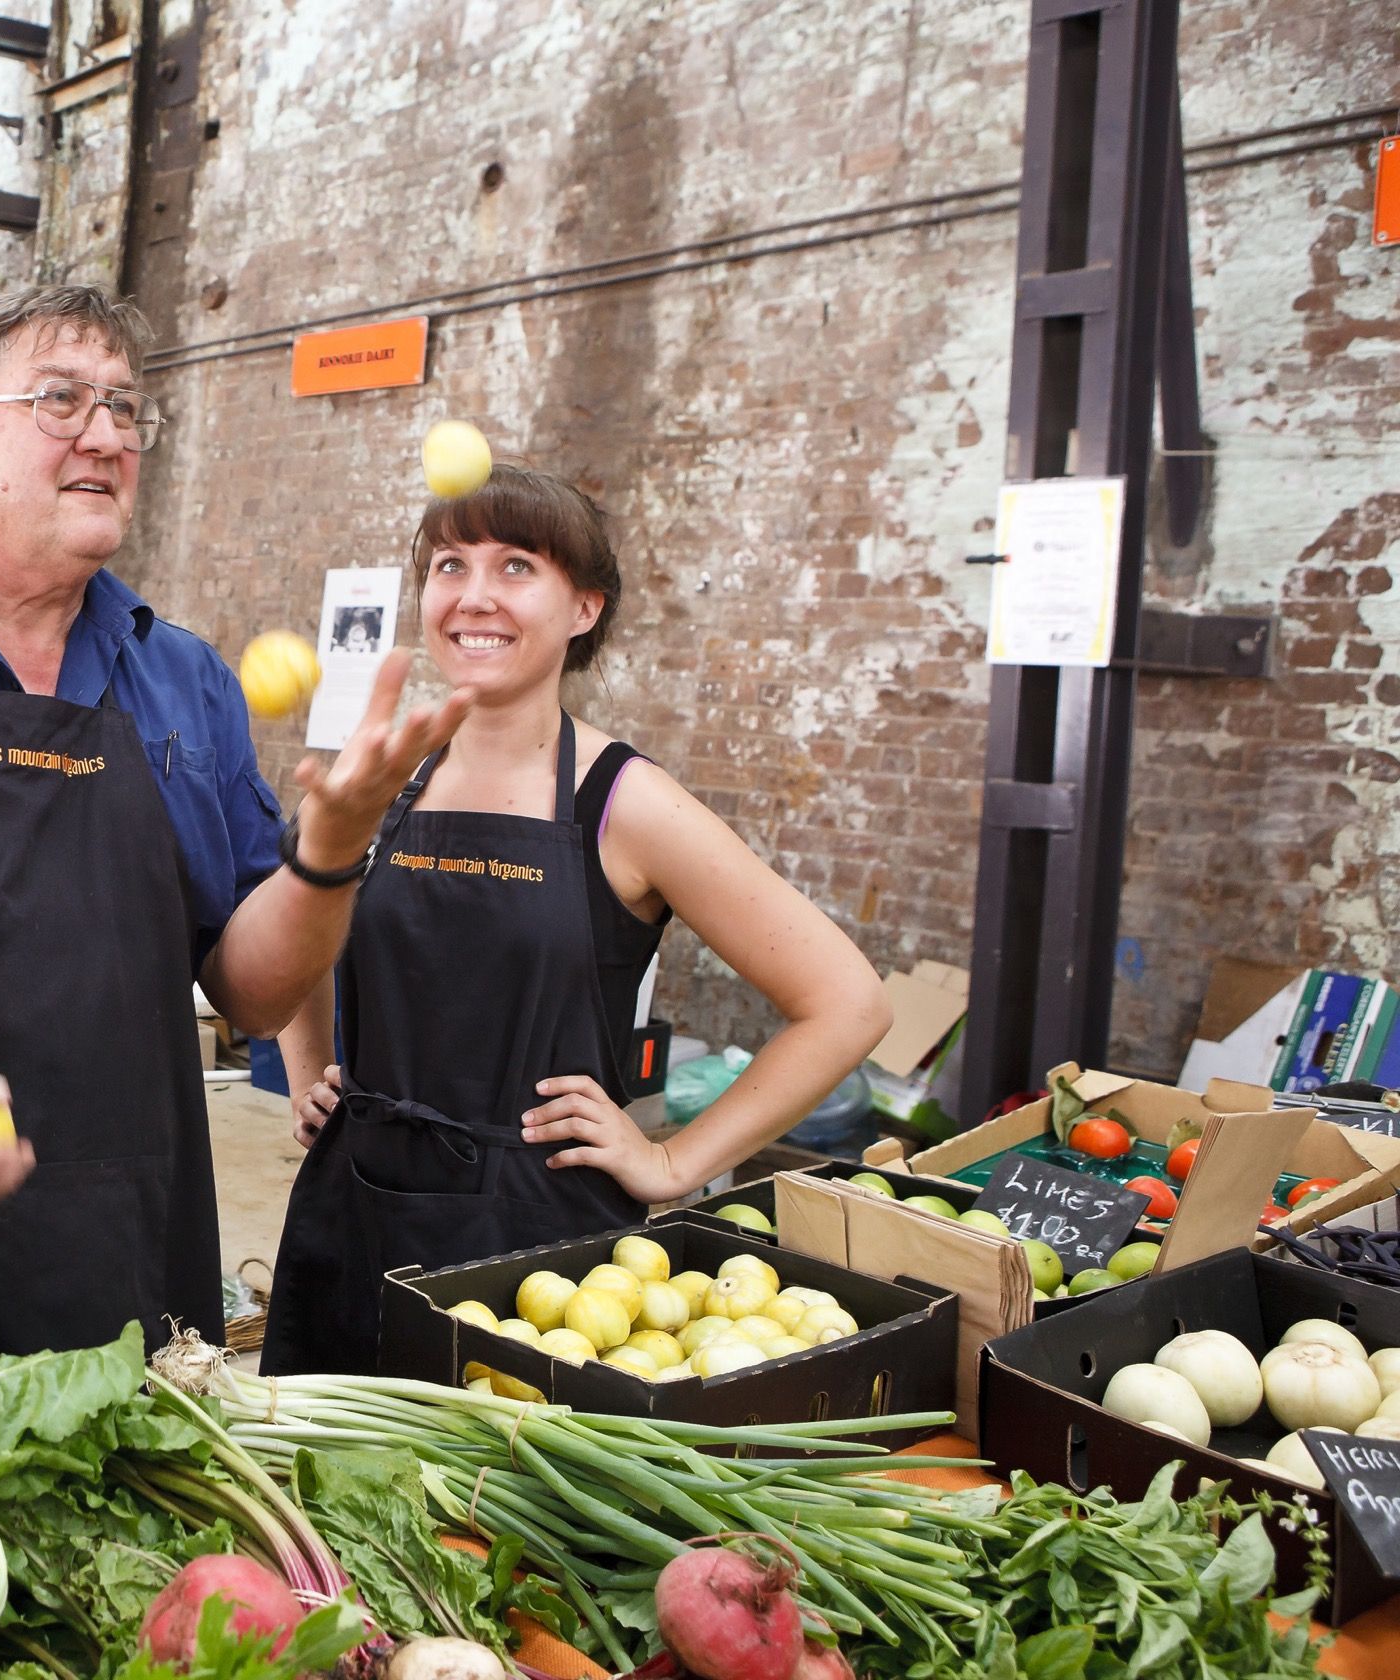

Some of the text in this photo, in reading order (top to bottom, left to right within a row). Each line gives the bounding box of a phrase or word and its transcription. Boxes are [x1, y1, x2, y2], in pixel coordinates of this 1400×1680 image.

[7, 748, 61, 770] mountain
[437, 857, 485, 875] mountain
[489, 859, 544, 882] organics
[1322, 1023, 1349, 1075] CELERY
